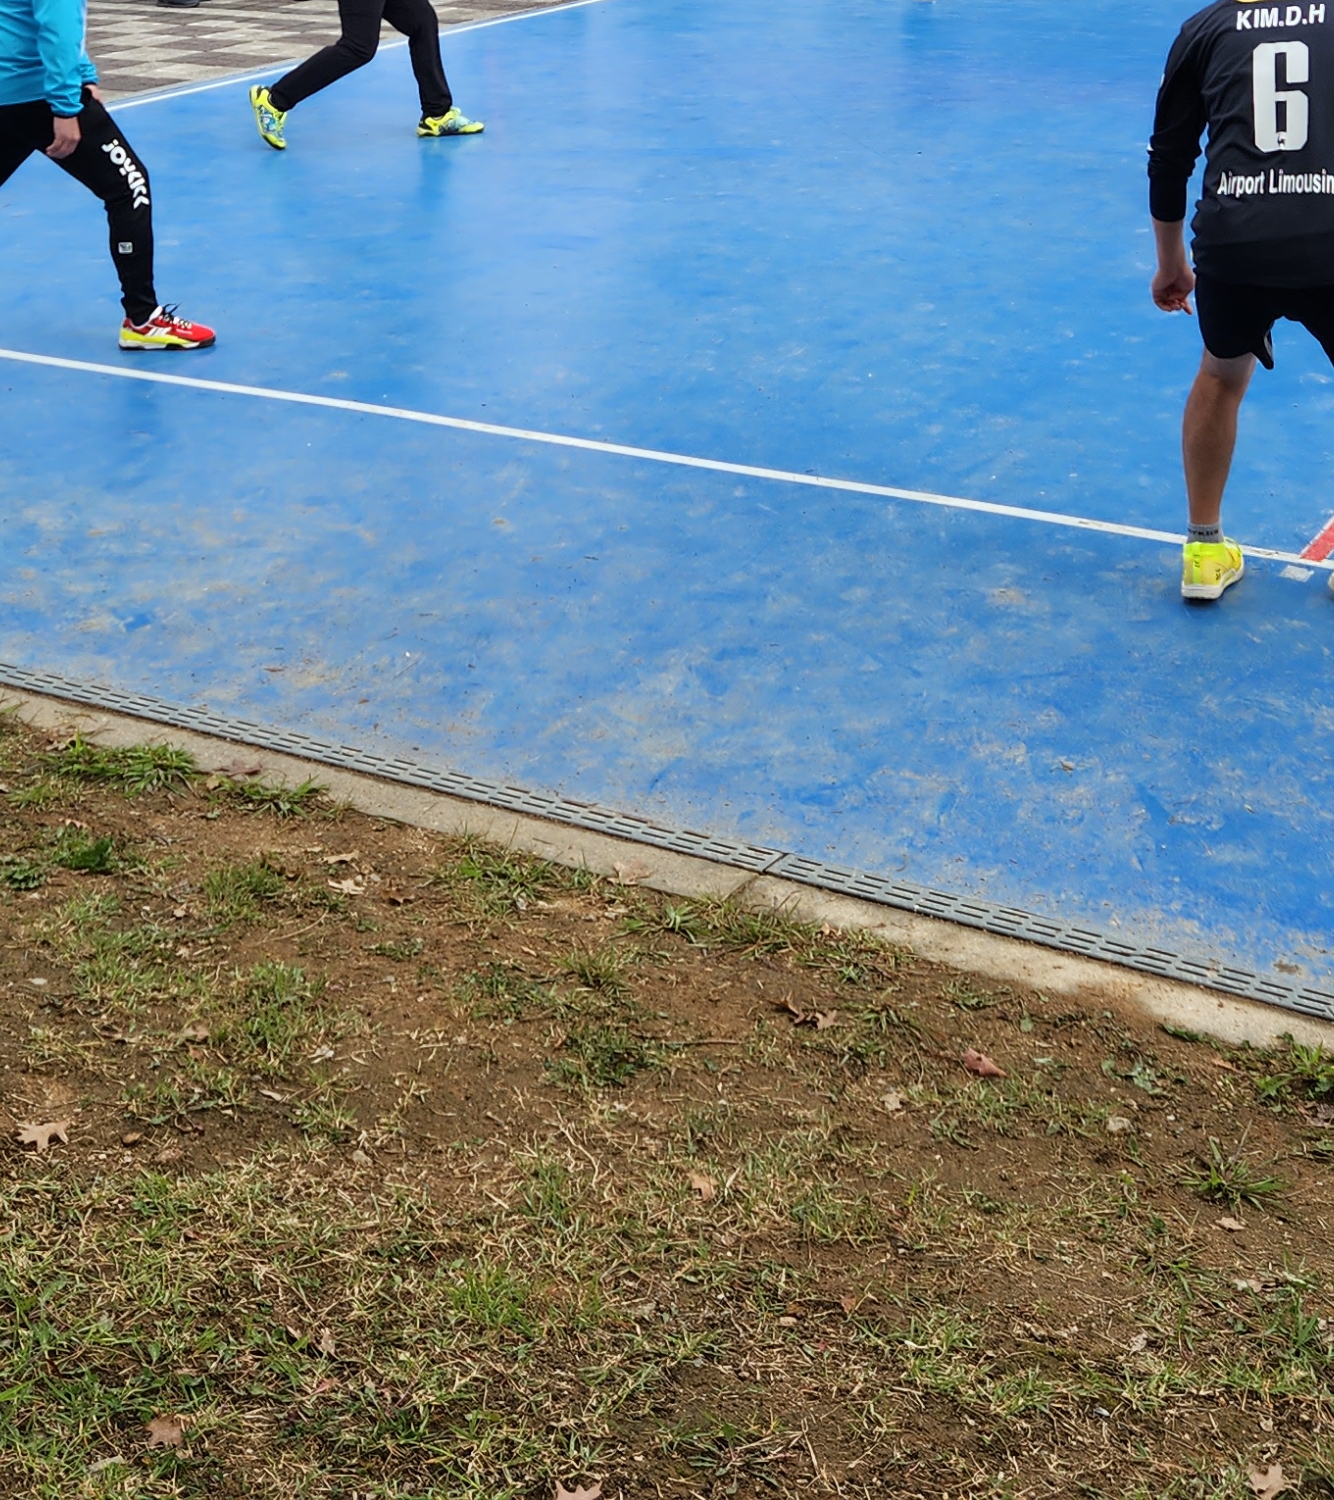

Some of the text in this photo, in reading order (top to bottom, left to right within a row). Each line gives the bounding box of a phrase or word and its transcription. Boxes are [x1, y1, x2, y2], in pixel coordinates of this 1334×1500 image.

[1235, 3, 1326, 31] KIM.D.H
[1252, 40, 1310, 154] 6
[1217, 170, 1265, 198] Airport
